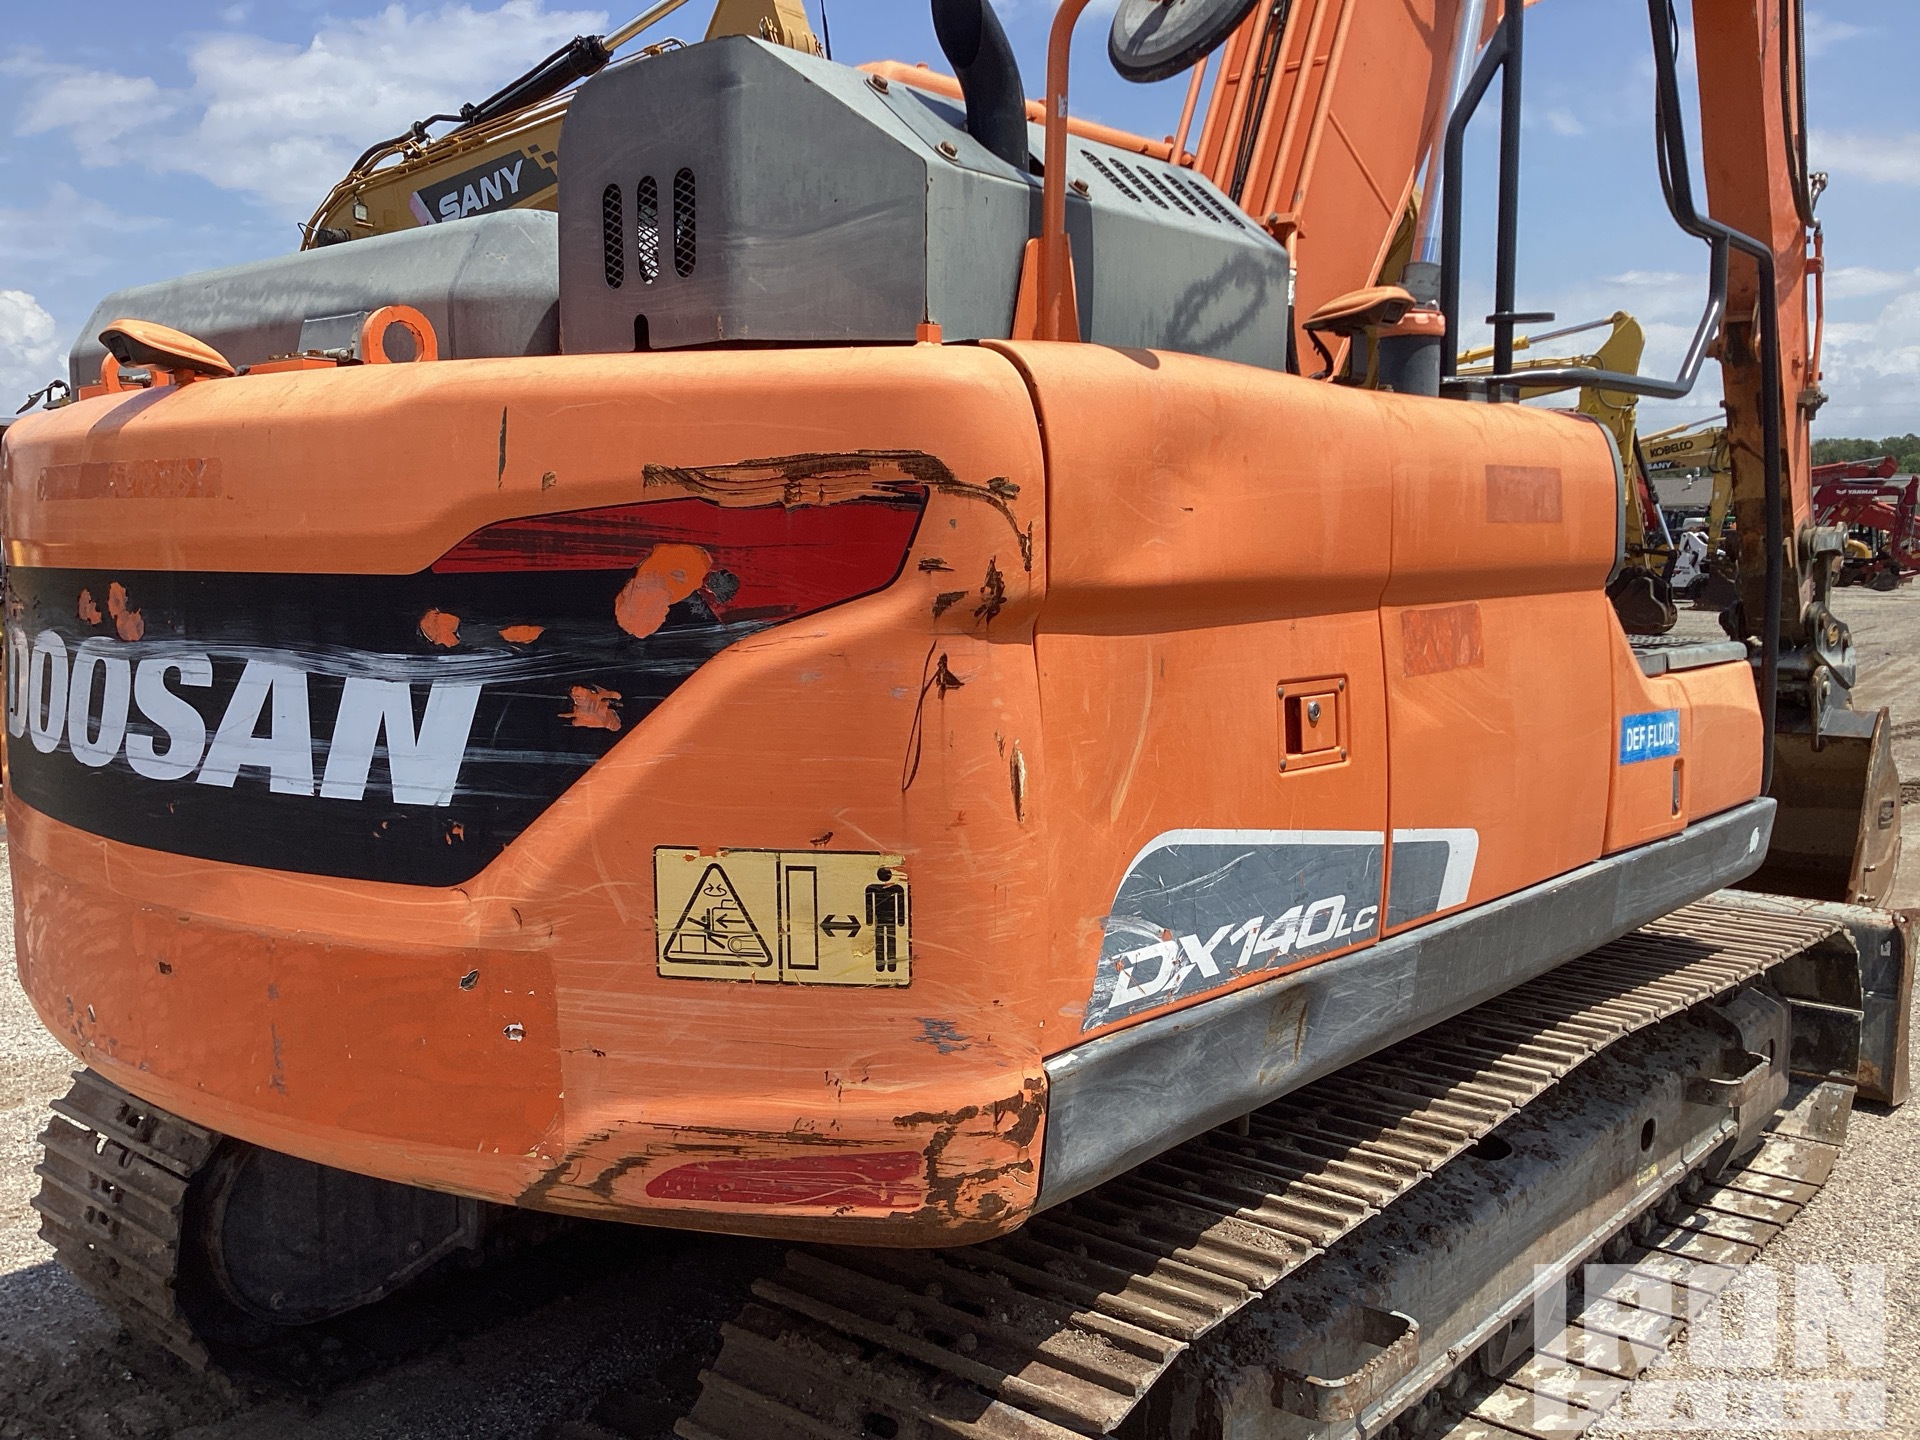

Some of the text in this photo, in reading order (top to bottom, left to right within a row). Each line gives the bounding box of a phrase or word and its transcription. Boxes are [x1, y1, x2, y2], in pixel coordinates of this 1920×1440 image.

[439, 159, 523, 223] SANY
[1650, 440, 1694, 458] KOBELCO
[8, 627, 483, 807] DOOSAN
[1626, 722, 1675, 752] DEF FLUID
